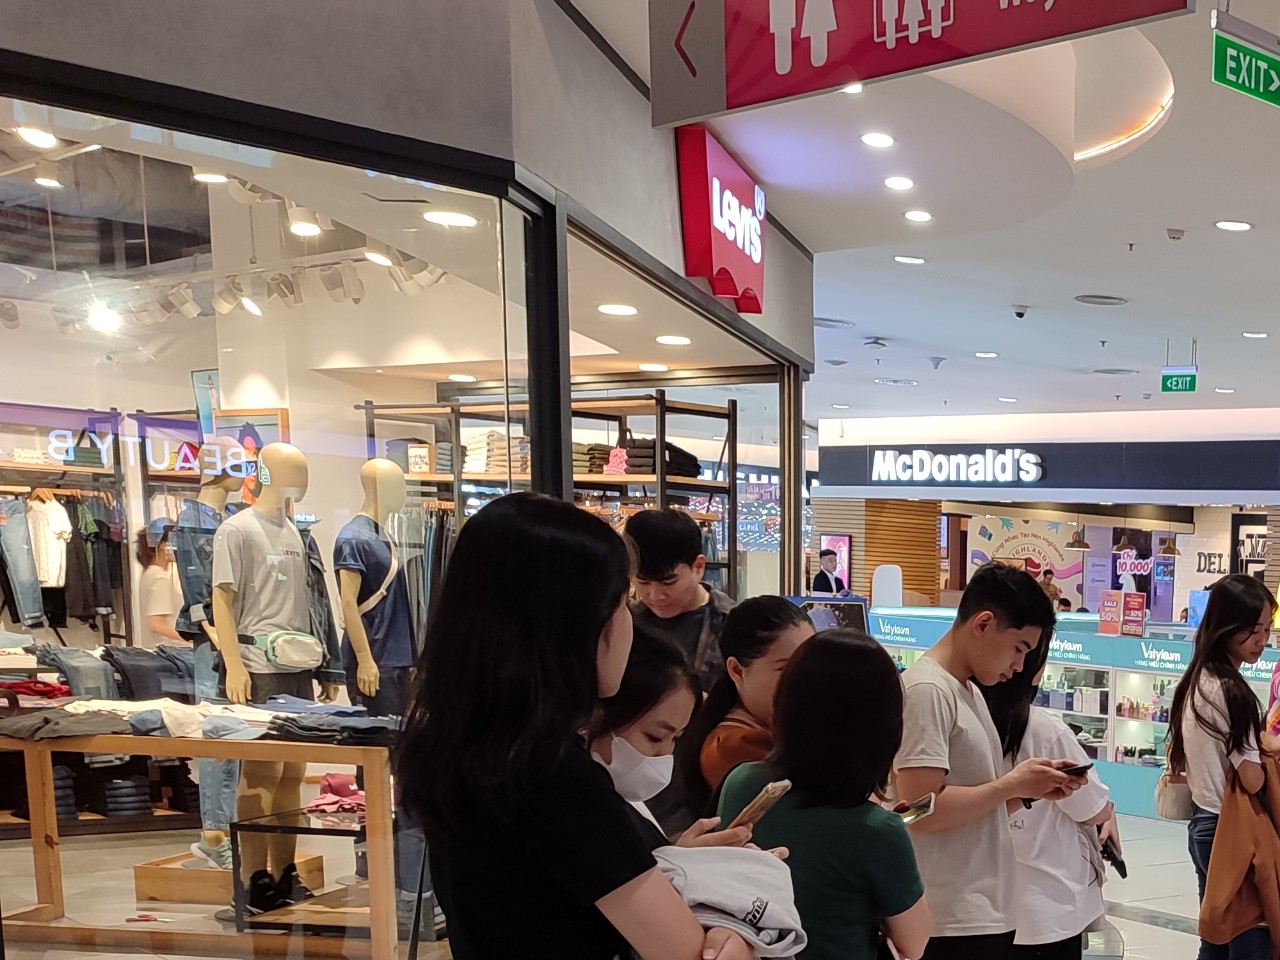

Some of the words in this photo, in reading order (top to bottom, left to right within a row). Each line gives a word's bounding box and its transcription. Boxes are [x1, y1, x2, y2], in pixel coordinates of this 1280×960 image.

[1226, 47, 1268, 93] EXIT
[1172, 377, 1191, 390] EXIT
[872, 449, 1043, 482] McDonald's
[1012, 545, 1050, 567] IGHLANDS
[1196, 552, 1229, 574] DEL
